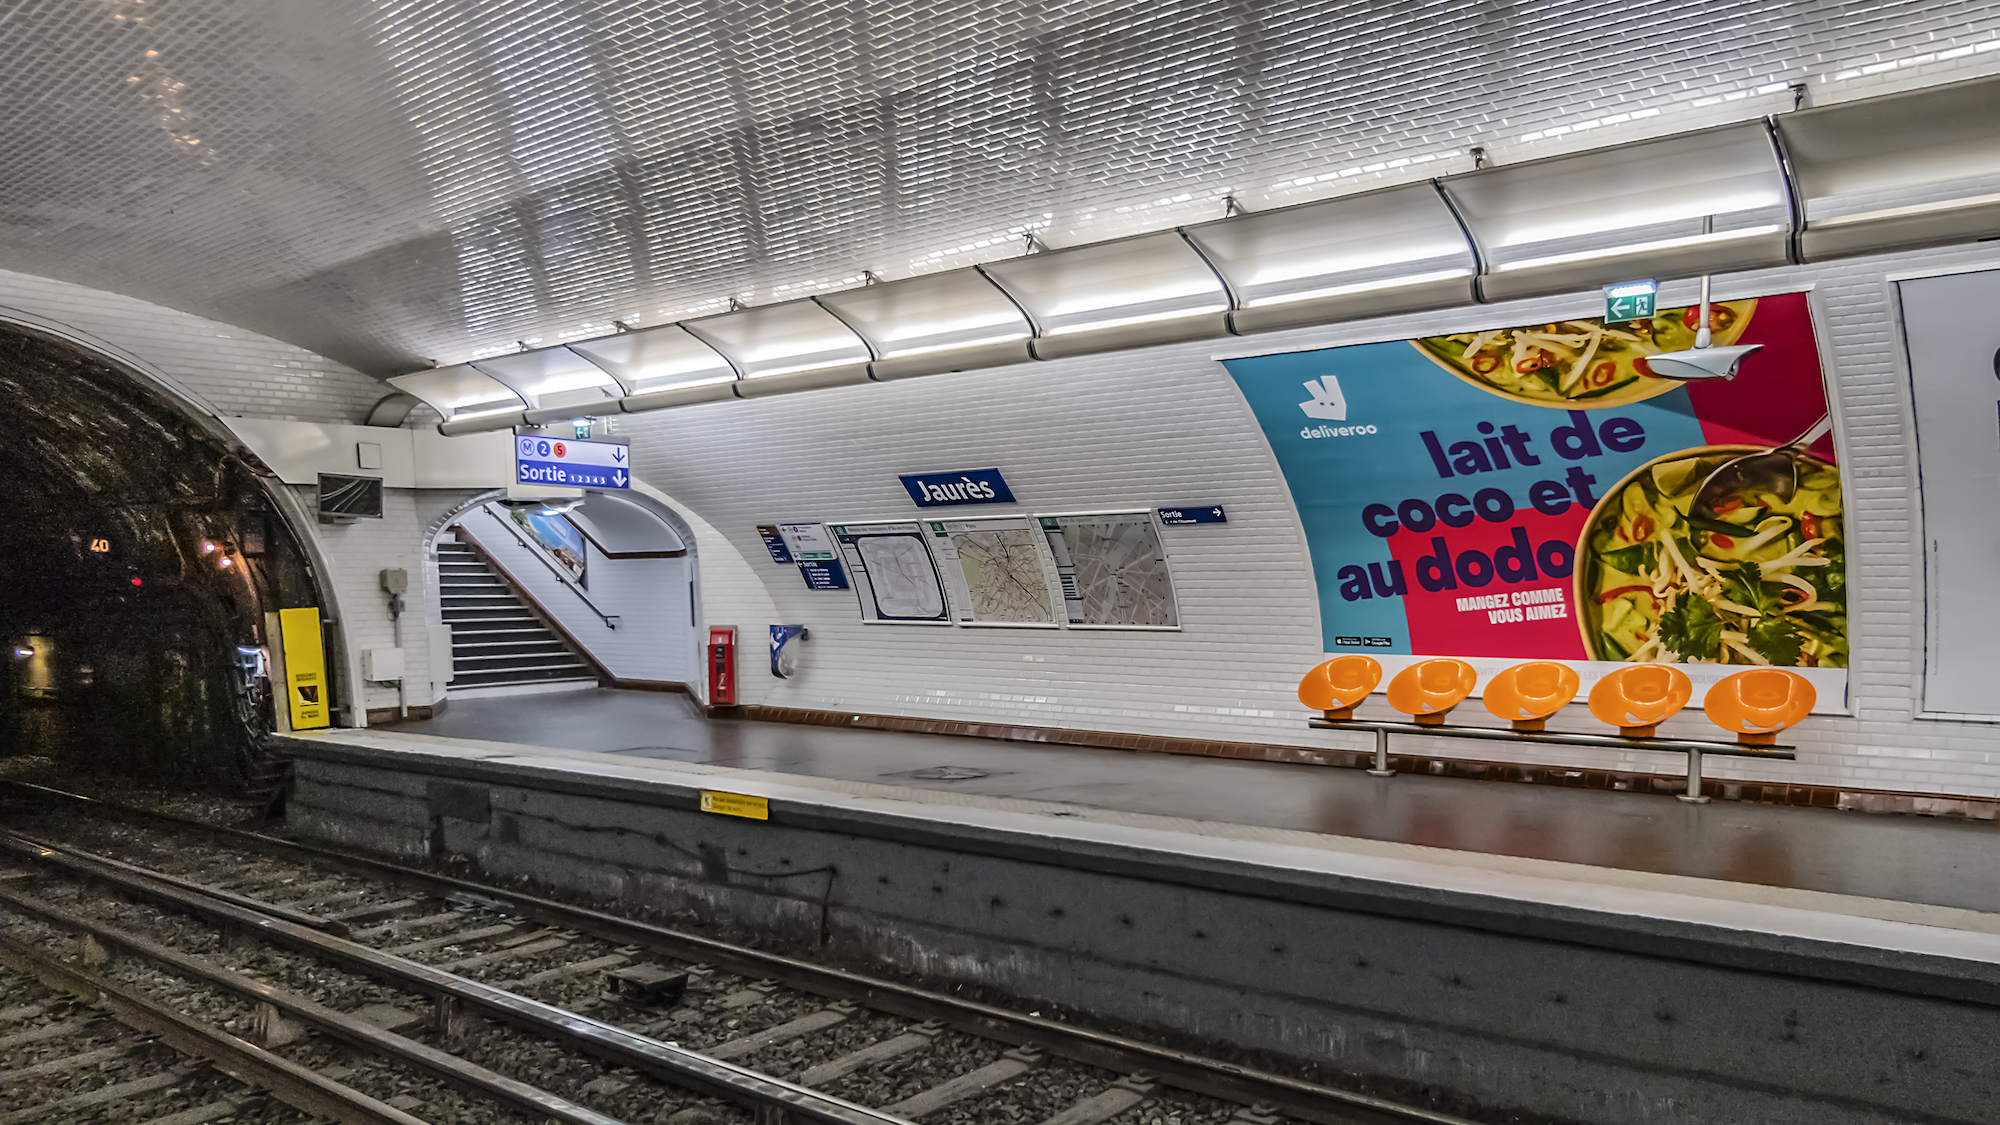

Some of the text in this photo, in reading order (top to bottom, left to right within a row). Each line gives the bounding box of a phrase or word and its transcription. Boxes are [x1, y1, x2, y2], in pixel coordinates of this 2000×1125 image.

[1300, 425, 1377, 439] deliveroo
[1419, 410, 1645, 479] lait de
[520, 464, 567, 482] Sortie
[917, 476, 995, 502] Jaurès
[1361, 466, 1600, 538] coco et
[1160, 510, 1183, 519] Sortie
[91, 539, 109, 552] 40
[1337, 526, 1576, 602] au dodo
[1456, 587, 1564, 612] MANGEZ COMME
[1488, 603, 1567, 625] VOUS AIMEZ
[1584, 670, 1598, 680] LES
